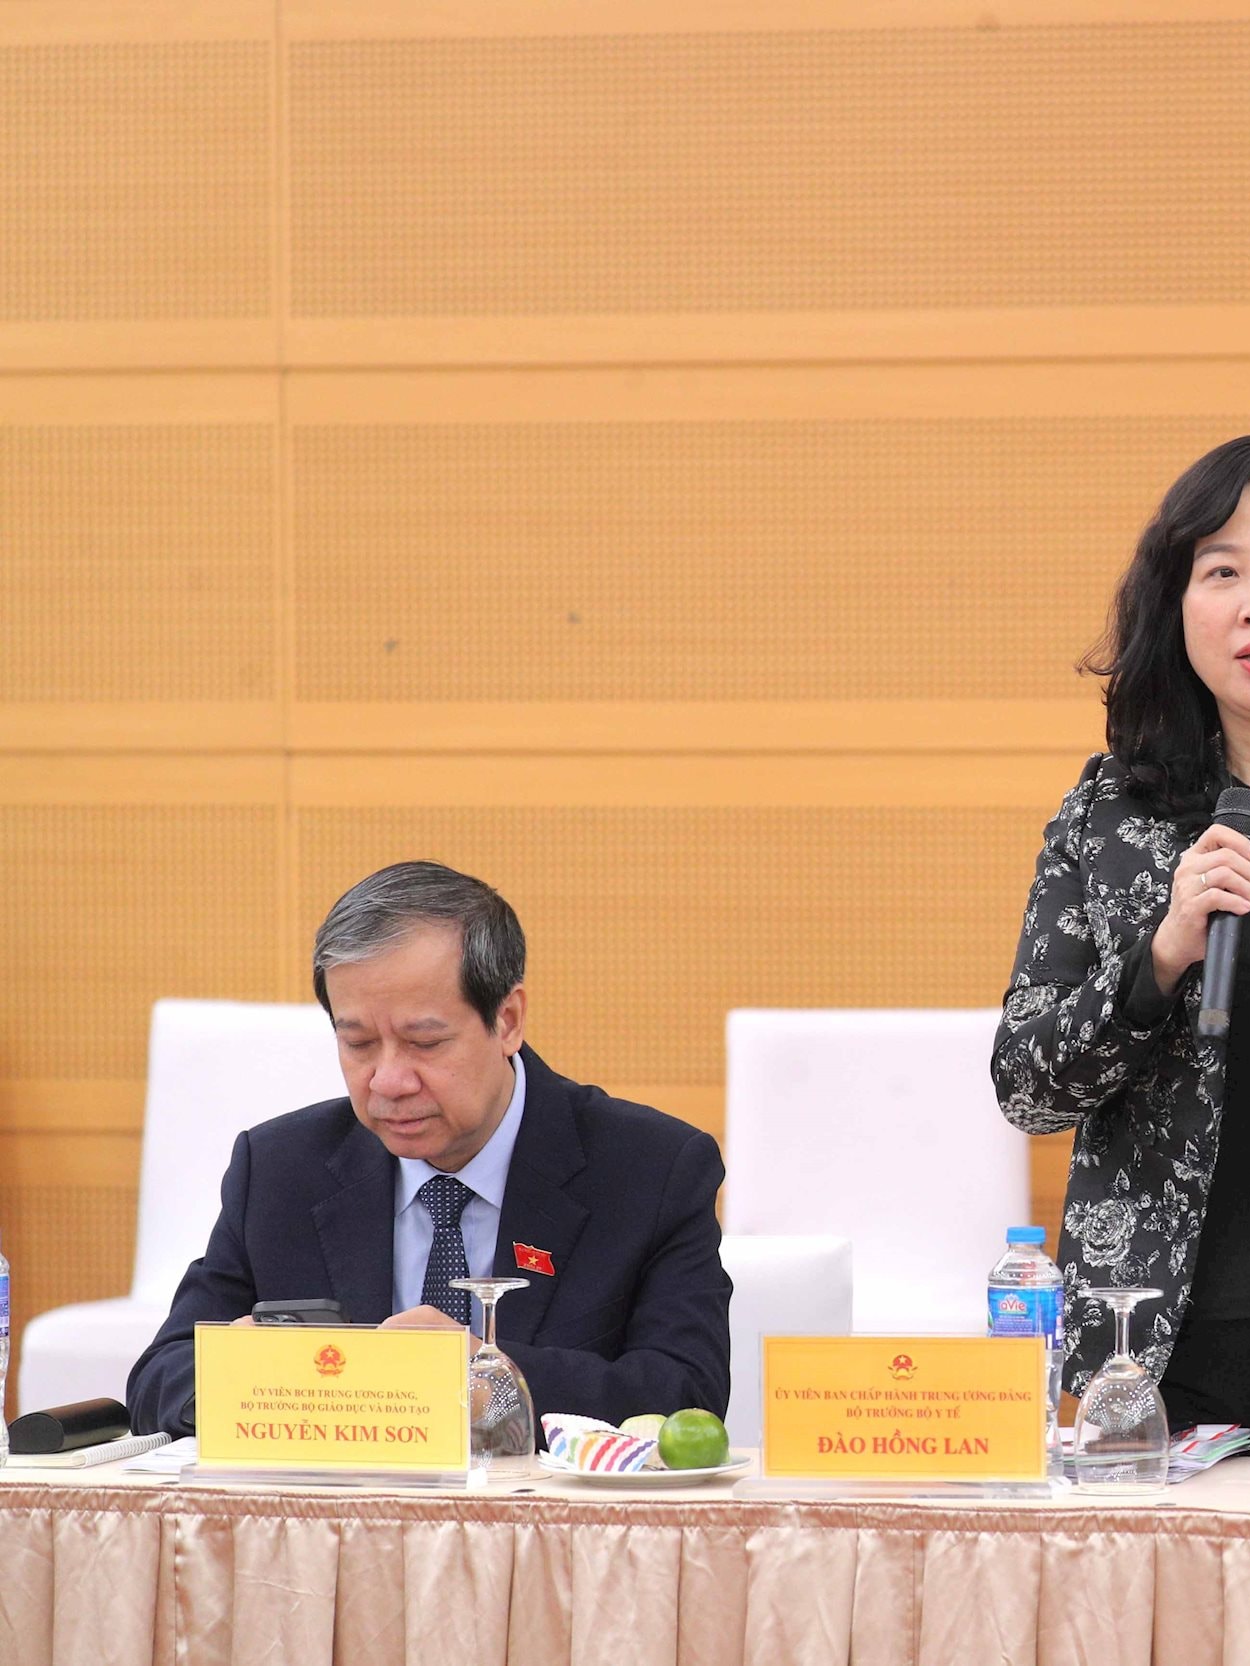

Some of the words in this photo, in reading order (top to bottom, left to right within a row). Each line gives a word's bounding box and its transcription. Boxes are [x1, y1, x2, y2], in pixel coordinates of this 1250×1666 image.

[268, 1387, 291, 1396] VIÊN
[295, 1389, 314, 1397] BCH
[318, 1390, 351, 1398] TRUNG
[355, 1390, 384, 1399] ƯƠNG
[794, 1388, 820, 1399] VIÊN
[824, 1391, 846, 1400] BAN
[850, 1388, 882, 1400] CHẤP
[884, 1388, 917, 1400] HÀNH
[921, 1392, 960, 1400] TRUNG
[963, 1390, 995, 1401] ƯƠNG
[999, 1389, 1031, 1401] ĐẢNG
[241, 1402, 254, 1411] BỘ
[302, 1403, 315, 1412] BỘ
[318, 1402, 343, 1412] GIÁO
[346, 1404, 366, 1414] DỤC
[369, 1403, 382, 1413] VÀ
[385, 1405, 406, 1413] ĐÀO
[409, 1406, 430, 1415] TẠO
[847, 1406, 862, 1417] BỘ
[917, 1407, 932, 1418] BỘ
[935, 1409, 942, 1418] Y
[946, 1406, 960, 1419] TẾ
[236, 1419, 326, 1440] NGUYỄN
[335, 1425, 378, 1442] KIM
[385, 1425, 429, 1443] SƠN
[818, 1432, 866, 1454] ĐÀO
[872, 1429, 937, 1454] HỒNG
[944, 1438, 988, 1454] LAN
